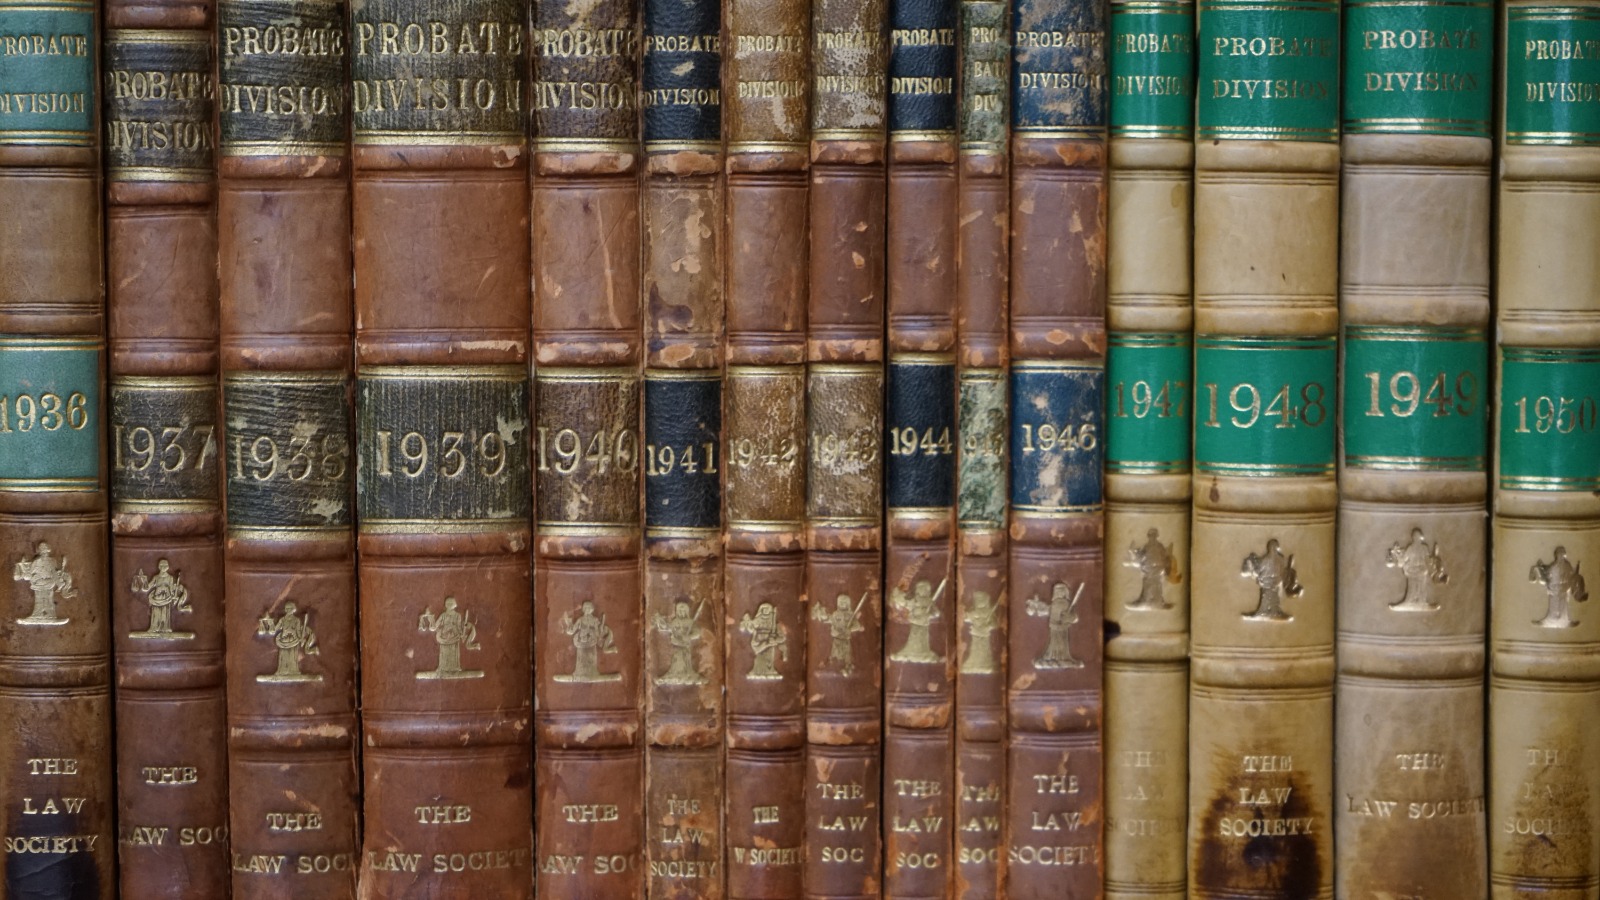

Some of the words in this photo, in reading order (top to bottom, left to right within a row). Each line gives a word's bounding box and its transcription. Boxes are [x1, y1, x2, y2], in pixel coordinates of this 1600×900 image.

[224, 26, 344, 56] PROBATE
[356, 22, 522, 56] PROBATE
[645, 35, 720, 54] PROBATE
[891, 28, 954, 46] PROBATE
[971, 27, 998, 43] PRO
[1016, 31, 1104, 48] PROBATE
[1363, 29, 1481, 49] PROBATE
[1213, 36, 1332, 57] PROBATE
[892, 77, 953, 95] DIVISION
[1020, 72, 1101, 89] DIVISION
[1213, 79, 1329, 99] DIVISION
[1364, 72, 1479, 92] DIVISION
[353, 78, 521, 113] DIVISION
[644, 88, 720, 108] DIVISION
[974, 94, 998, 112] DIV
[1114, 380, 1187, 419] 1947
[1365, 370, 1478, 418] 1949
[0, 393, 89, 433] 1936
[1204, 382, 1326, 429] 1948
[1515, 396, 1597, 434] 1950
[891, 426, 953, 455] 1944
[1022, 423, 1097, 451] 1946
[114, 424, 215, 472] 1937
[234, 433, 347, 481] 1938
[376, 430, 507, 478] 1939
[536, 427, 639, 475] 1940
[728, 438, 798, 468] 1942
[813, 432, 878, 463] 1943
[647, 442, 717, 476] 1941
[27, 758, 78, 775] THE
[1243, 756, 1292, 772] THE
[1396, 753, 1445, 770] THE
[142, 767, 198, 784] THE
[1033, 774, 1079, 794] THE
[816, 783, 864, 799] THE
[894, 779, 942, 797] THE
[1239, 787, 1292, 804] LAW
[23, 798, 87, 815] LAW
[414, 806, 472, 823] THE
[562, 804, 619, 822] THE
[667, 799, 700, 815] THE
[752, 806, 779, 824] THE
[1346, 794, 1397, 817] LAW
[266, 812, 323, 832] THE
[817, 816, 868, 831] LAW
[893, 816, 943, 833] LAW
[1031, 811, 1084, 832] LAW
[1219, 818, 1314, 837] SOCIETY
[3, 835, 99, 853] SOCIETY
[661, 826, 705, 843] LAW
[233, 853, 286, 873] LAW
[368, 851, 422, 872] LAW
[821, 846, 865, 863] SOC
[895, 853, 941, 869] SOC
[650, 860, 717, 878] SOCIETY
